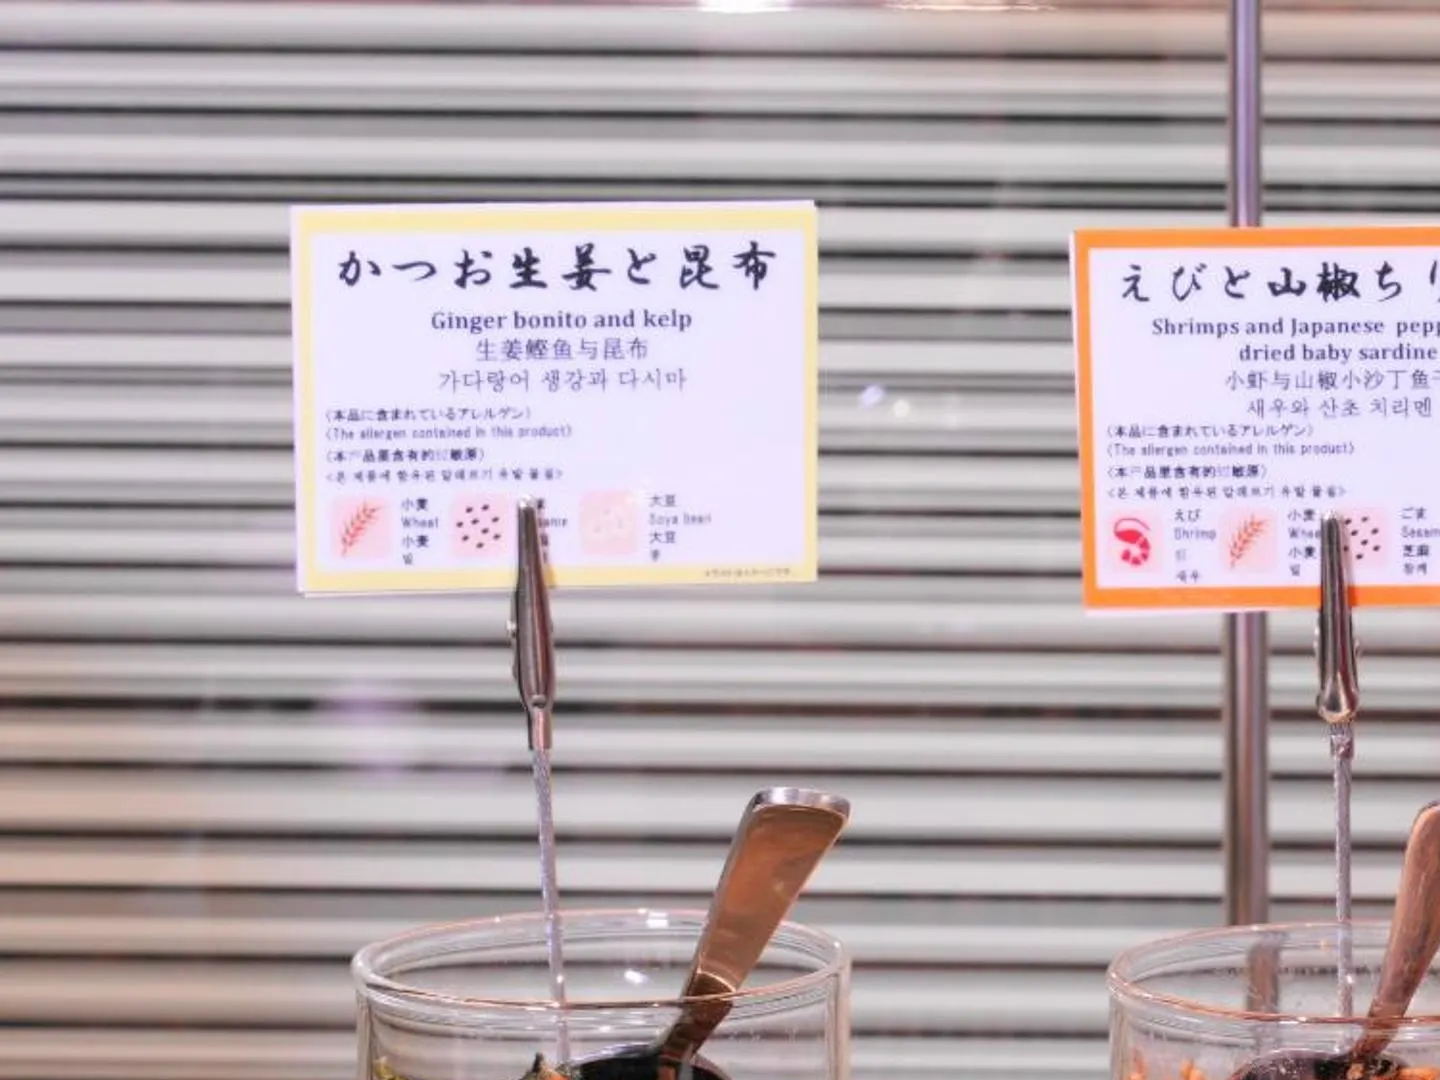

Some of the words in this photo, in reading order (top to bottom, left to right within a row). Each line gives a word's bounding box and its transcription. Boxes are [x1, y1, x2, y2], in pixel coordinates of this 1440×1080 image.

[339, 240, 776, 292] かつお生姜と昆布
[431, 312, 507, 334] Ginger
[514, 310, 587, 329] bonito
[594, 309, 635, 328] and
[644, 309, 692, 332] kelp
[1152, 318, 1239, 338] Shrimps
[1245, 317, 1283, 335] and
[1291, 318, 1384, 338] Japanese
[477, 337, 647, 361] 生姜鲣鱼与昆布
[1239, 344, 1295, 361] dried
[1302, 344, 1352, 364] baby
[1359, 342, 1437, 360] sardine
[440, 369, 529, 393] 가다랑어
[541, 368, 608, 392] 생강과
[618, 368, 687, 391] 다시마
[1319, 397, 1360, 418] 산초
[360, 428, 406, 440] allergen
[412, 426, 471, 439] contained
[476, 426, 486, 438] in
[491, 426, 513, 438] this
[1141, 444, 1188, 457] allergen
[1194, 443, 1252, 455] contained
[1257, 442, 1268, 455] in
[1273, 443, 1296, 455] this
[1175, 508, 1201, 522] えび
[1286, 526, 1321, 540] Whea
